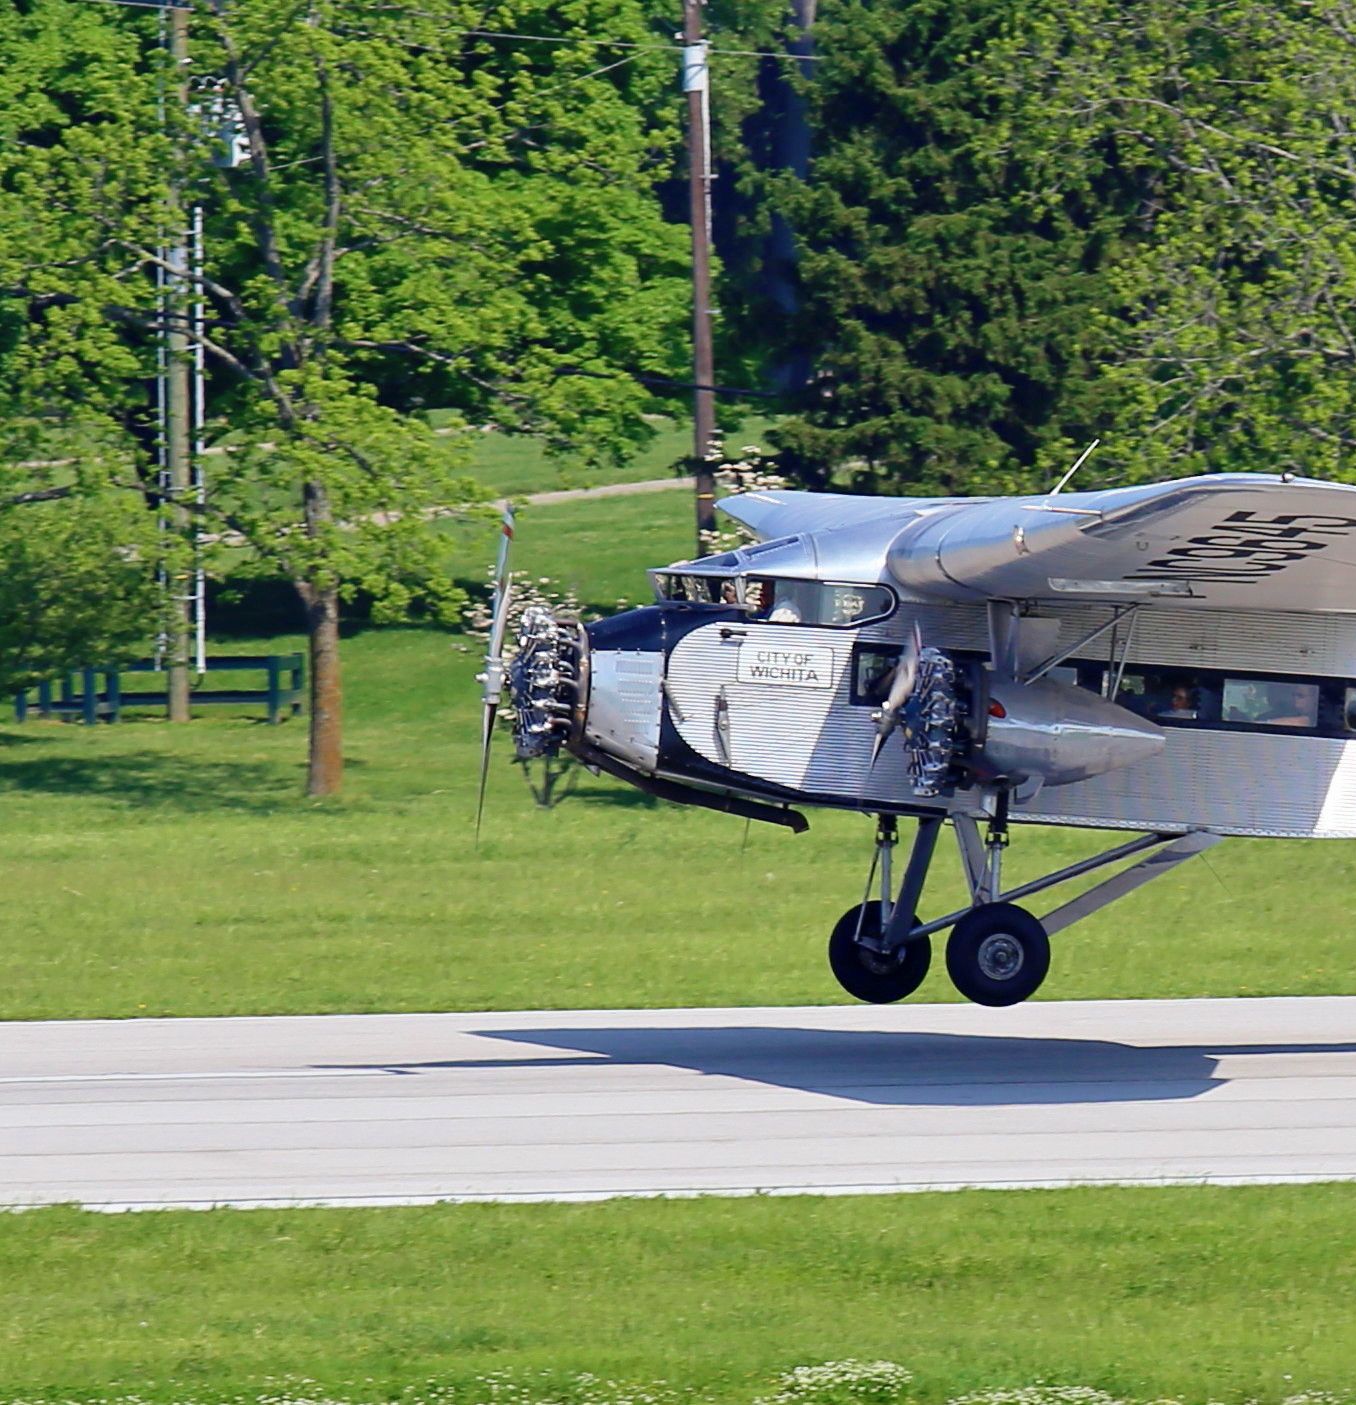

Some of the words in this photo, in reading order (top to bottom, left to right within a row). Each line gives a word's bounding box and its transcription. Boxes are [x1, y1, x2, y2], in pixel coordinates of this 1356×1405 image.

[758, 651, 791, 664] CITY
[794, 654, 814, 665] OF
[750, 666, 819, 681] WICHITA
